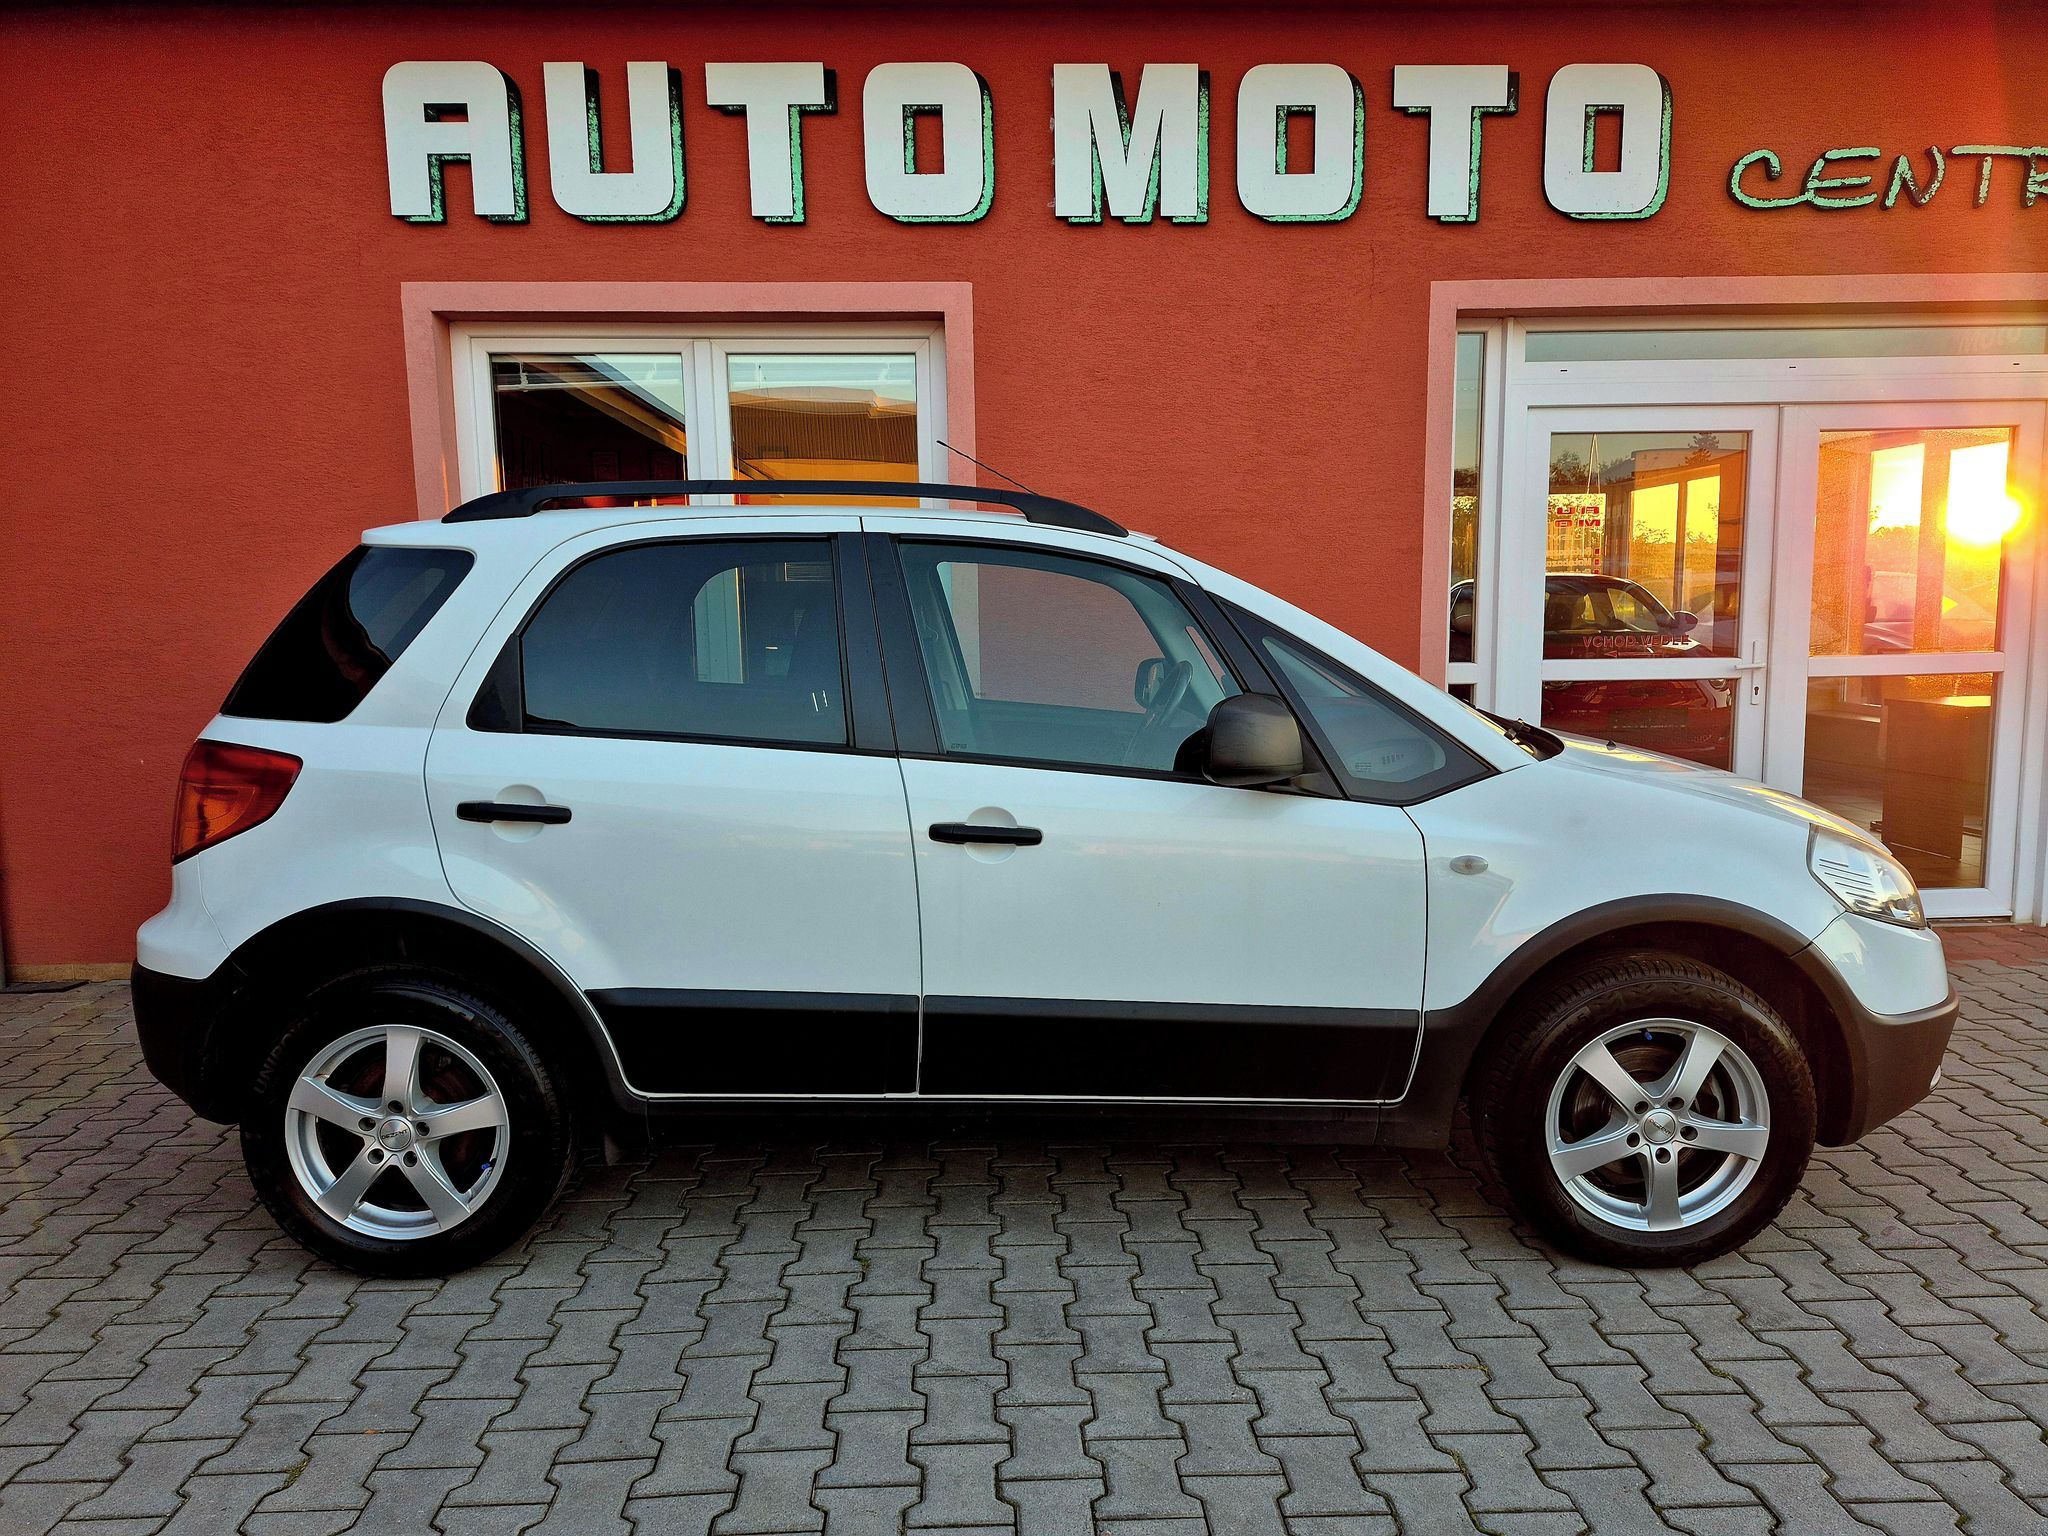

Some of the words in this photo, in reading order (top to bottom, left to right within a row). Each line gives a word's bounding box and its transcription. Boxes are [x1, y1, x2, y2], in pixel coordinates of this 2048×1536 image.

[382, 61, 994, 224] AUTO
[1052, 63, 1672, 224] MOTO
[1582, 635, 1637, 648] VCHOD
[1639, 634, 1690, 647] VEDLE
